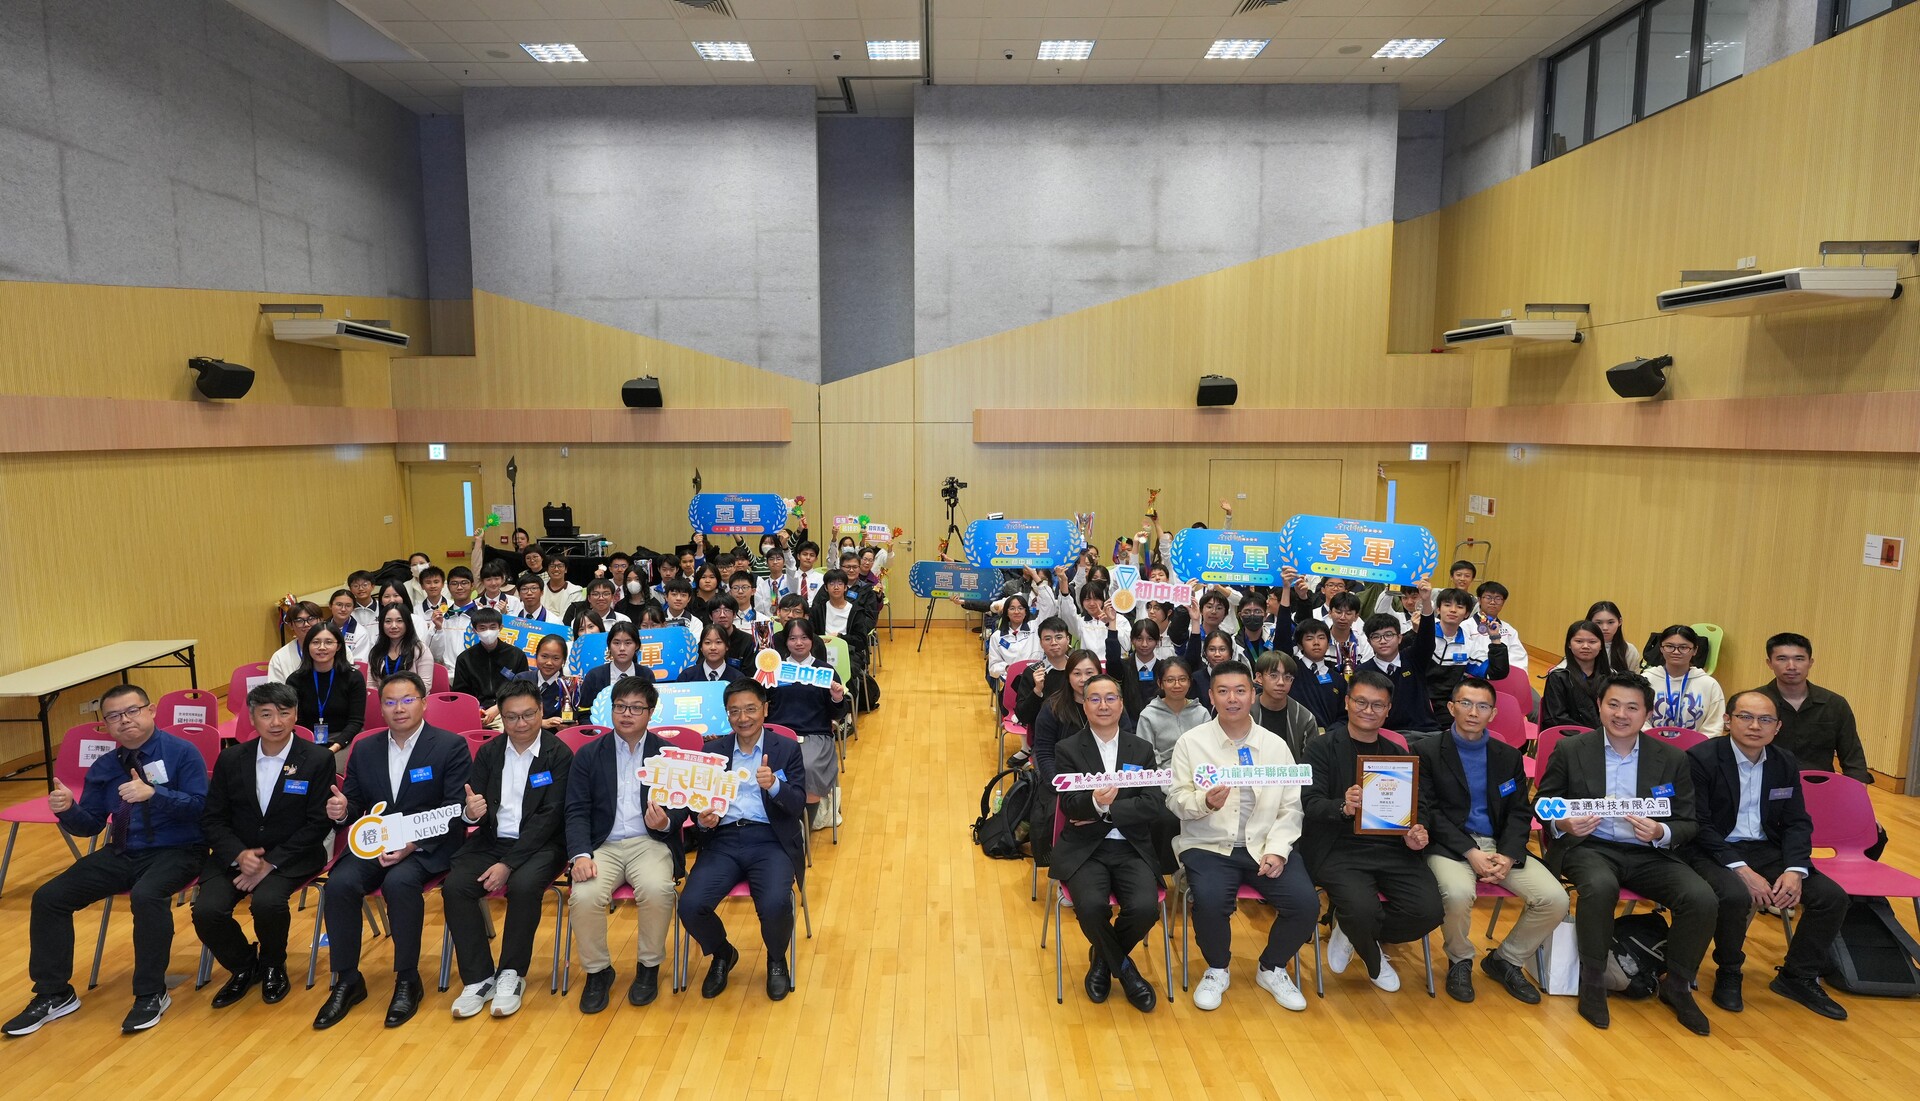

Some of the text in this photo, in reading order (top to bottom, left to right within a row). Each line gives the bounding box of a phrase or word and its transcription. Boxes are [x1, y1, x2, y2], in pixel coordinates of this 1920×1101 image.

[715, 504, 761, 524] 亞軍
[995, 532, 1050, 556] 冠軍
[1319, 532, 1395, 567] 季軍
[1207, 543, 1269, 571] 殿軍
[935, 571, 979, 590] 亞軍
[1135, 582, 1190, 603] 初中組
[780, 663, 832, 686] 高中組
[683, 754, 704, 764] 第四屆
[648, 758, 738, 799] 全民國情
[1220, 766, 1311, 779] 九龍青年聯席會議
[655, 790, 724, 812] 知識大賽
[1570, 800, 1669, 810] 雲通科技有限公司
[413, 805, 460, 825] ORANGE
[362, 829, 378, 846] 橙
[381, 826, 389, 841] 新聞
[414, 823, 447, 839] NEWS
